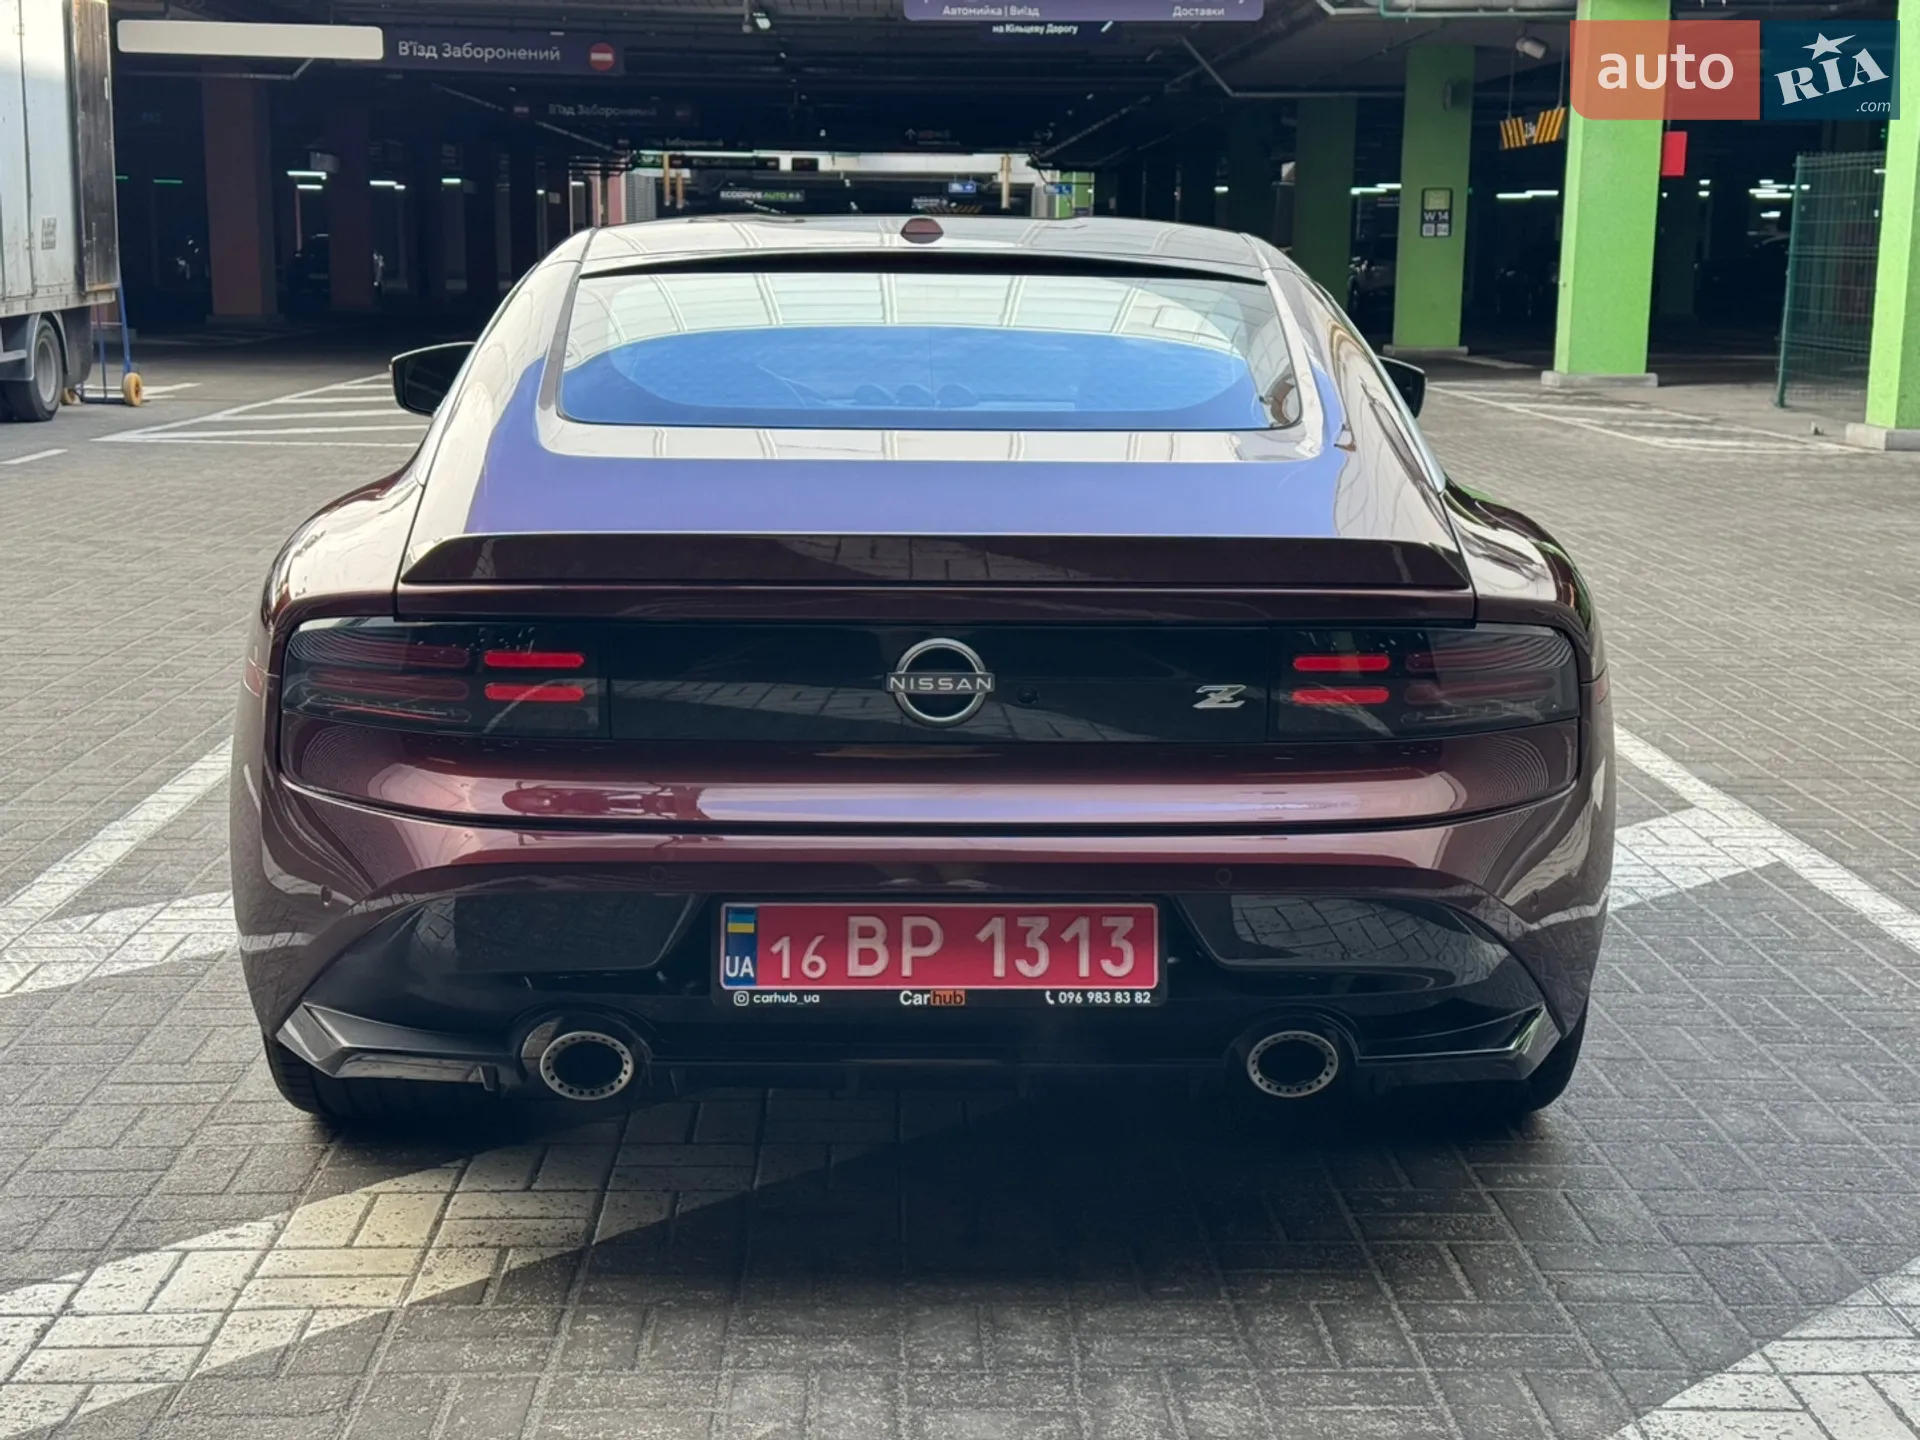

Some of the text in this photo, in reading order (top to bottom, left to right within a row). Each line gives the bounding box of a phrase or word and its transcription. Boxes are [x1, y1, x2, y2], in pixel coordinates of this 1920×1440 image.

[942, 5, 1002, 16] Автомийка
[1172, 6, 1225, 17] Доставки
[1046, 24, 1078, 35] Дорогу
[398, 40, 561, 63] В'їзд Заборонений
[1424, 211, 1437, 221] W
[889, 676, 992, 691] NISSAN
[1192, 685, 1247, 709] Z
[770, 916, 1134, 979] 16 BP 1313
[725, 956, 755, 978] UA
[753, 991, 820, 1005] carhub_ua
[899, 990, 963, 1005] Carhub
[1058, 991, 1151, 1004] 096 983 83 82
